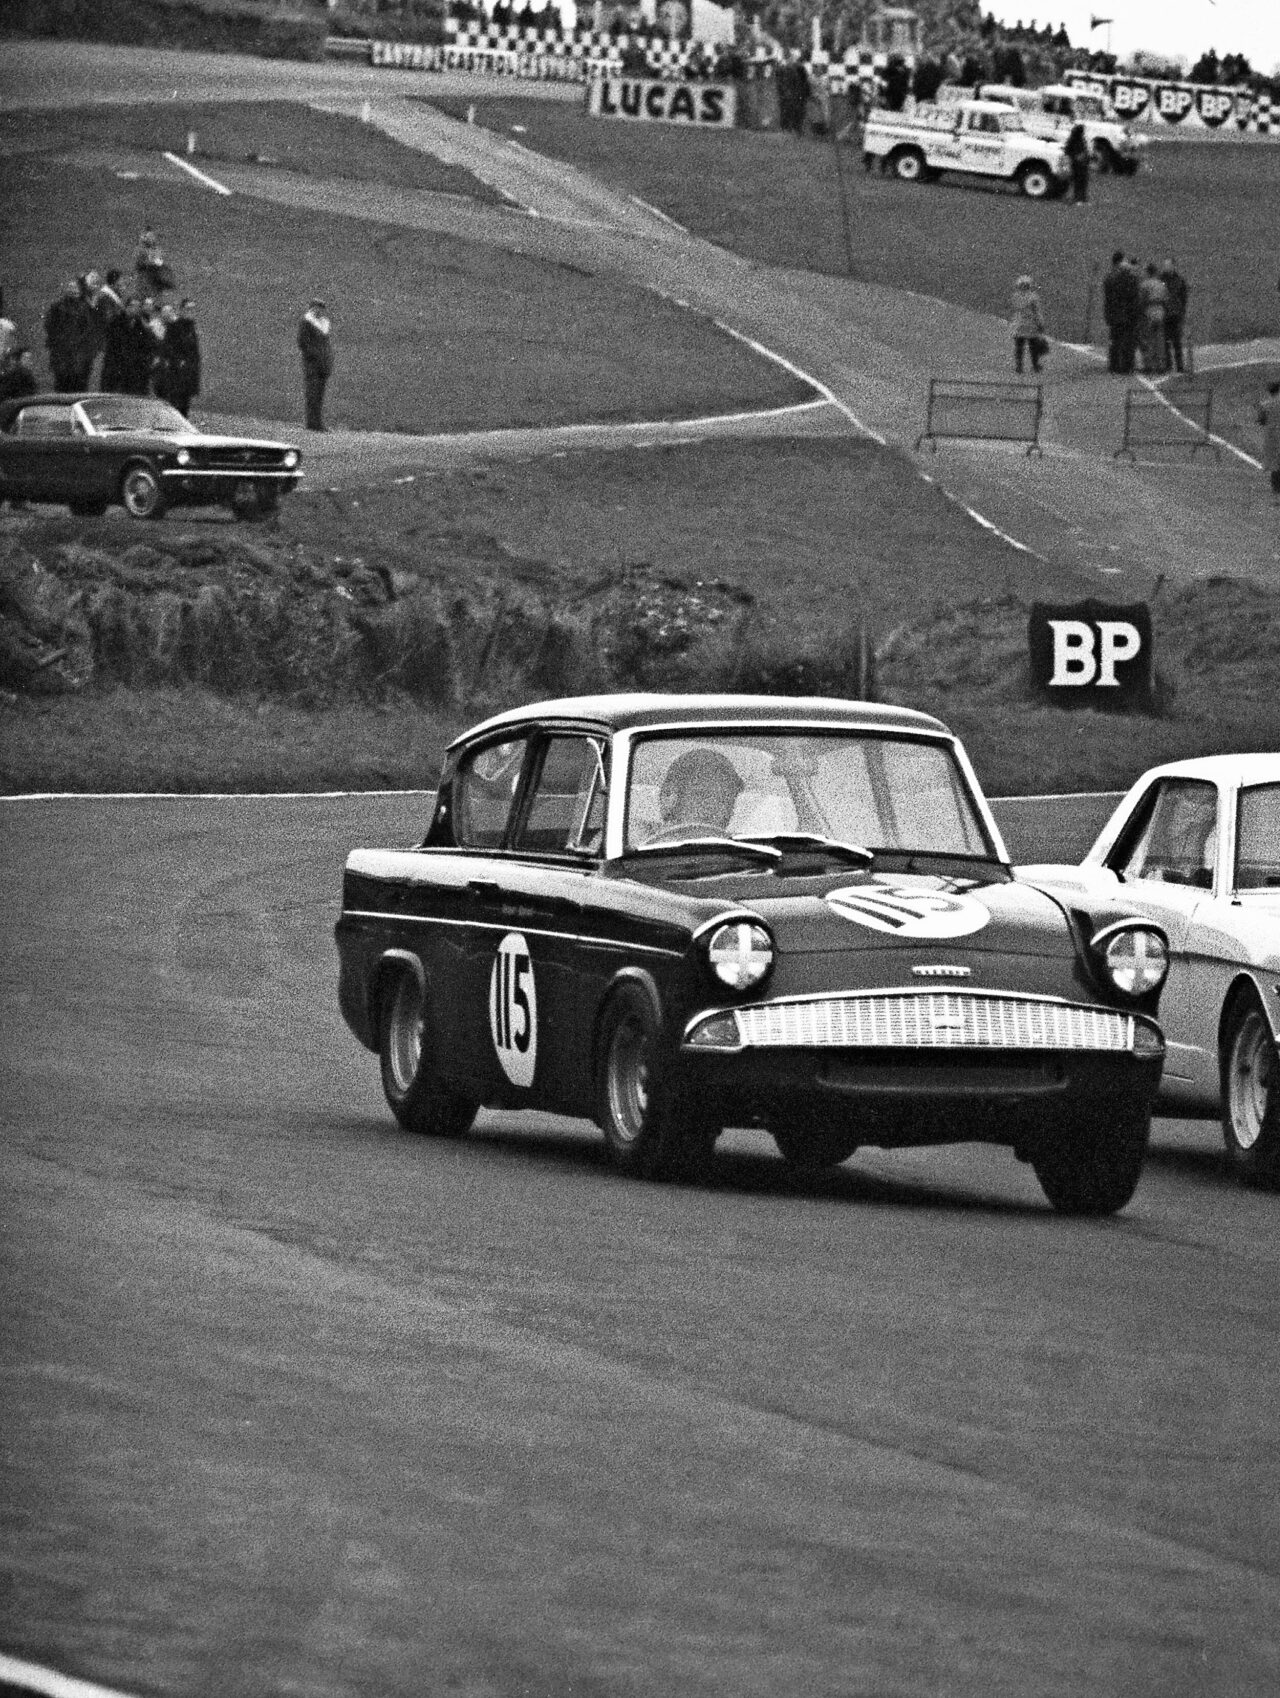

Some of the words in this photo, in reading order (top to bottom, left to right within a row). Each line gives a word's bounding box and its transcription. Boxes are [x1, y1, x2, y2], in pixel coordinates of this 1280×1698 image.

[600, 81, 725, 122] LUCAS
[1115, 85, 1149, 110] BP
[1160, 89, 1192, 114] BP
[1201, 93, 1232, 118] BP
[1047, 620, 1141, 685] BP
[827, 887, 965, 929] 115
[495, 952, 531, 1053] 115
